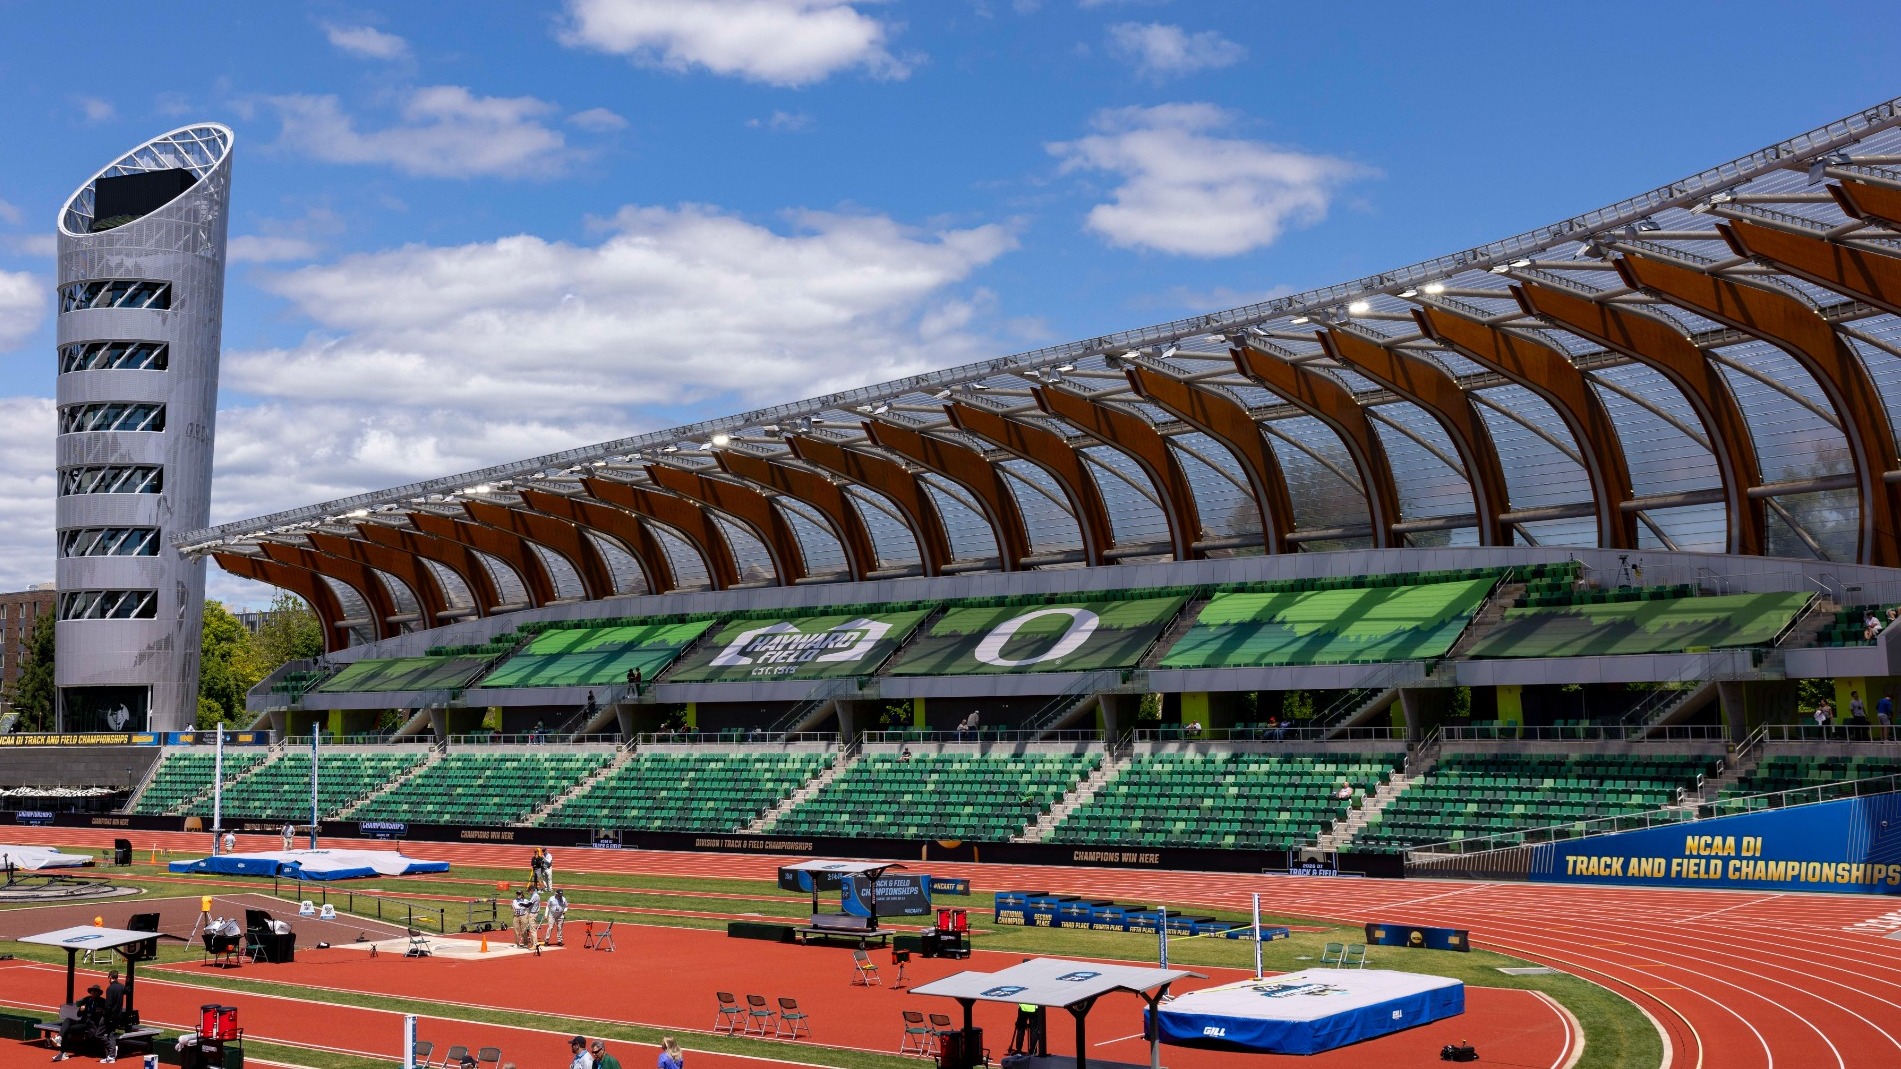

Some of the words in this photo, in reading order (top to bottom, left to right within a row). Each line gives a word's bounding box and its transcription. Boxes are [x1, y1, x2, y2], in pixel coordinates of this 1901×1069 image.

[747, 632, 861, 651] HAYWARD
[757, 649, 821, 664] FIELD
[25, 735, 45, 744] TRACK
[46, 735, 59, 744] AND
[61, 735, 77, 744] FIELD
[78, 734, 128, 744] CHAMPIONSHIPS
[461, 830, 490, 839] CHAMPIONS
[490, 831, 501, 840] WIN
[501, 831, 515, 840] HERE
[695, 838, 720, 847] DIVISION
[725, 839, 742, 849] TRACK
[743, 840, 748, 849] &
[748, 841, 764, 849] FIELD
[765, 841, 813, 851] CHAMPIONSHIPS
[1685, 835, 1735, 856] NCAA
[1741, 836, 1762, 857] DI
[1073, 851, 1120, 862] CHAMPIONS
[1121, 852, 1137, 863] WIN
[1138, 853, 1160, 864] HERE
[1289, 868, 1311, 876] TRACK
[1566, 855, 1624, 876] TRACK
[1627, 857, 1666, 878] AND
[1670, 858, 1723, 879] FIELD
[1728, 859, 1901, 886] CHAMPIONSHIPS
[893, 879, 911, 887] FIELD
[1000, 910, 1024, 918] NATIONAL
[997, 917, 1025, 925] CHAMPION
[1093, 923, 1110, 931] FOURTH
[1203, 1026, 1226, 1037] GILL
